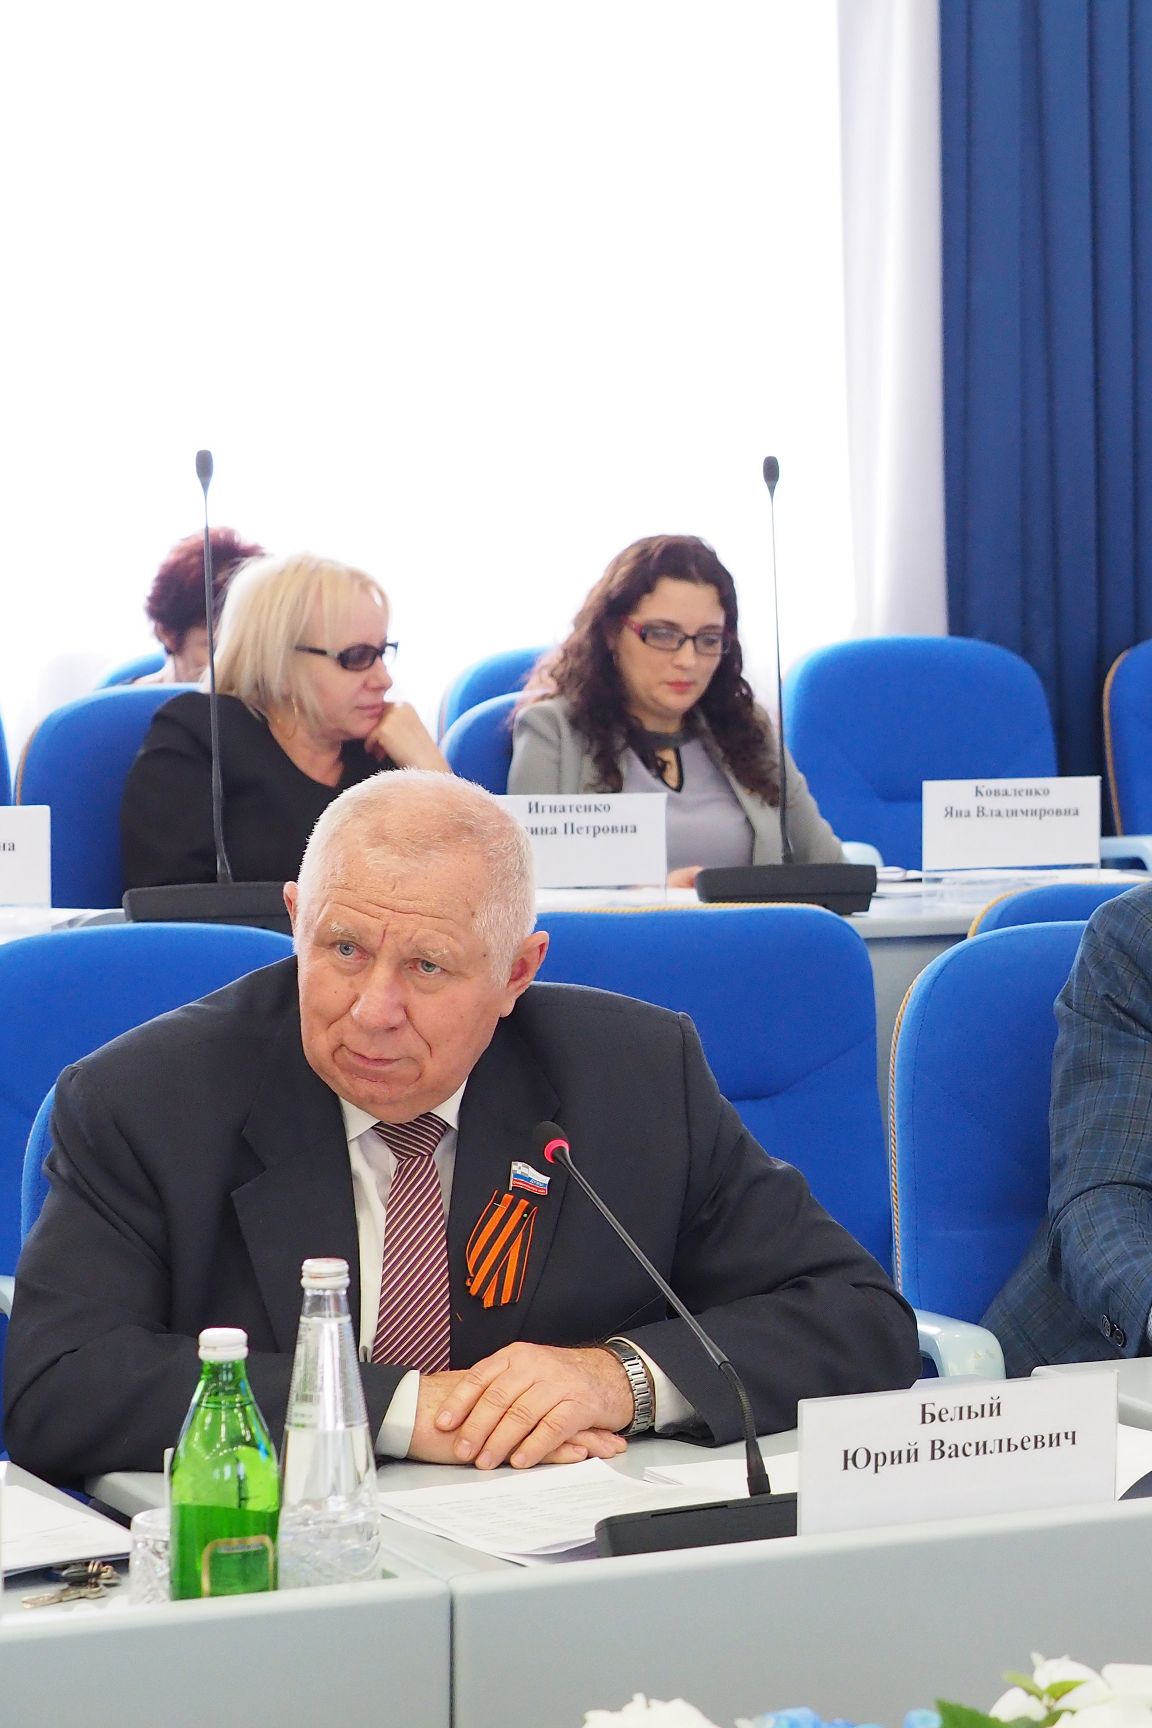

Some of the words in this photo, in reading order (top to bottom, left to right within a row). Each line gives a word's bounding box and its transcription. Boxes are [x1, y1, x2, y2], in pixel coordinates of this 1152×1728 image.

[974, 785, 1050, 798] Коваленко
[527, 800, 612, 815] Игнатенко
[943, 806, 972, 819] Яна
[976, 805, 1080, 821] Владимировна
[562, 821, 638, 839] Петровна
[919, 1395, 1003, 1426] Белый
[840, 1440, 920, 1475] Юрий
[928, 1428, 1078, 1462] Васильевич
